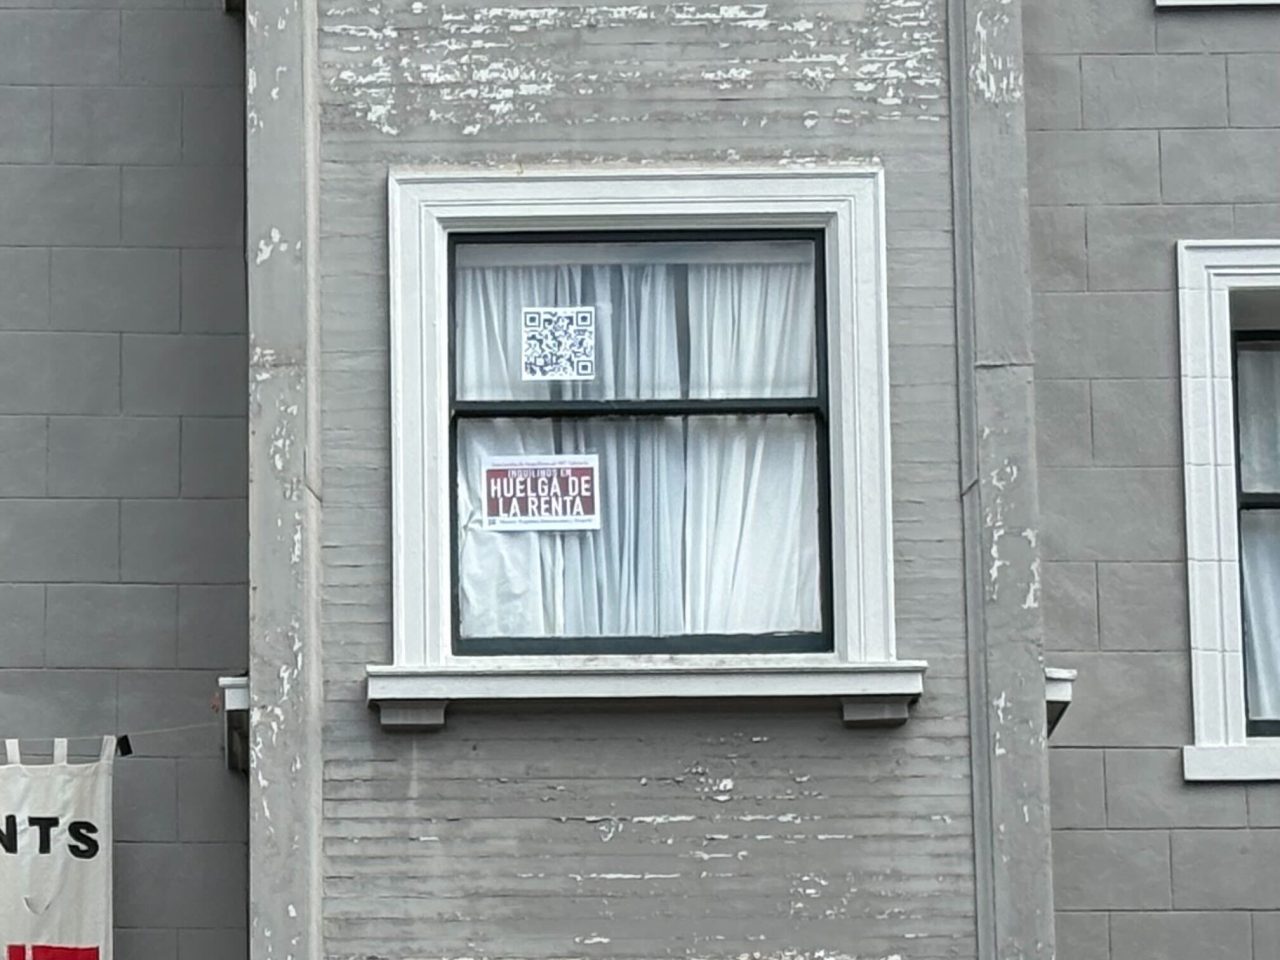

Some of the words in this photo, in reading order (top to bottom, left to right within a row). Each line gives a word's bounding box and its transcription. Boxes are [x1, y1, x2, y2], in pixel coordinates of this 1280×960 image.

[490, 477, 561, 499] HUELGA
[568, 475, 592, 497] DE
[498, 497, 521, 519] LA
[528, 495, 585, 518] RENTA
